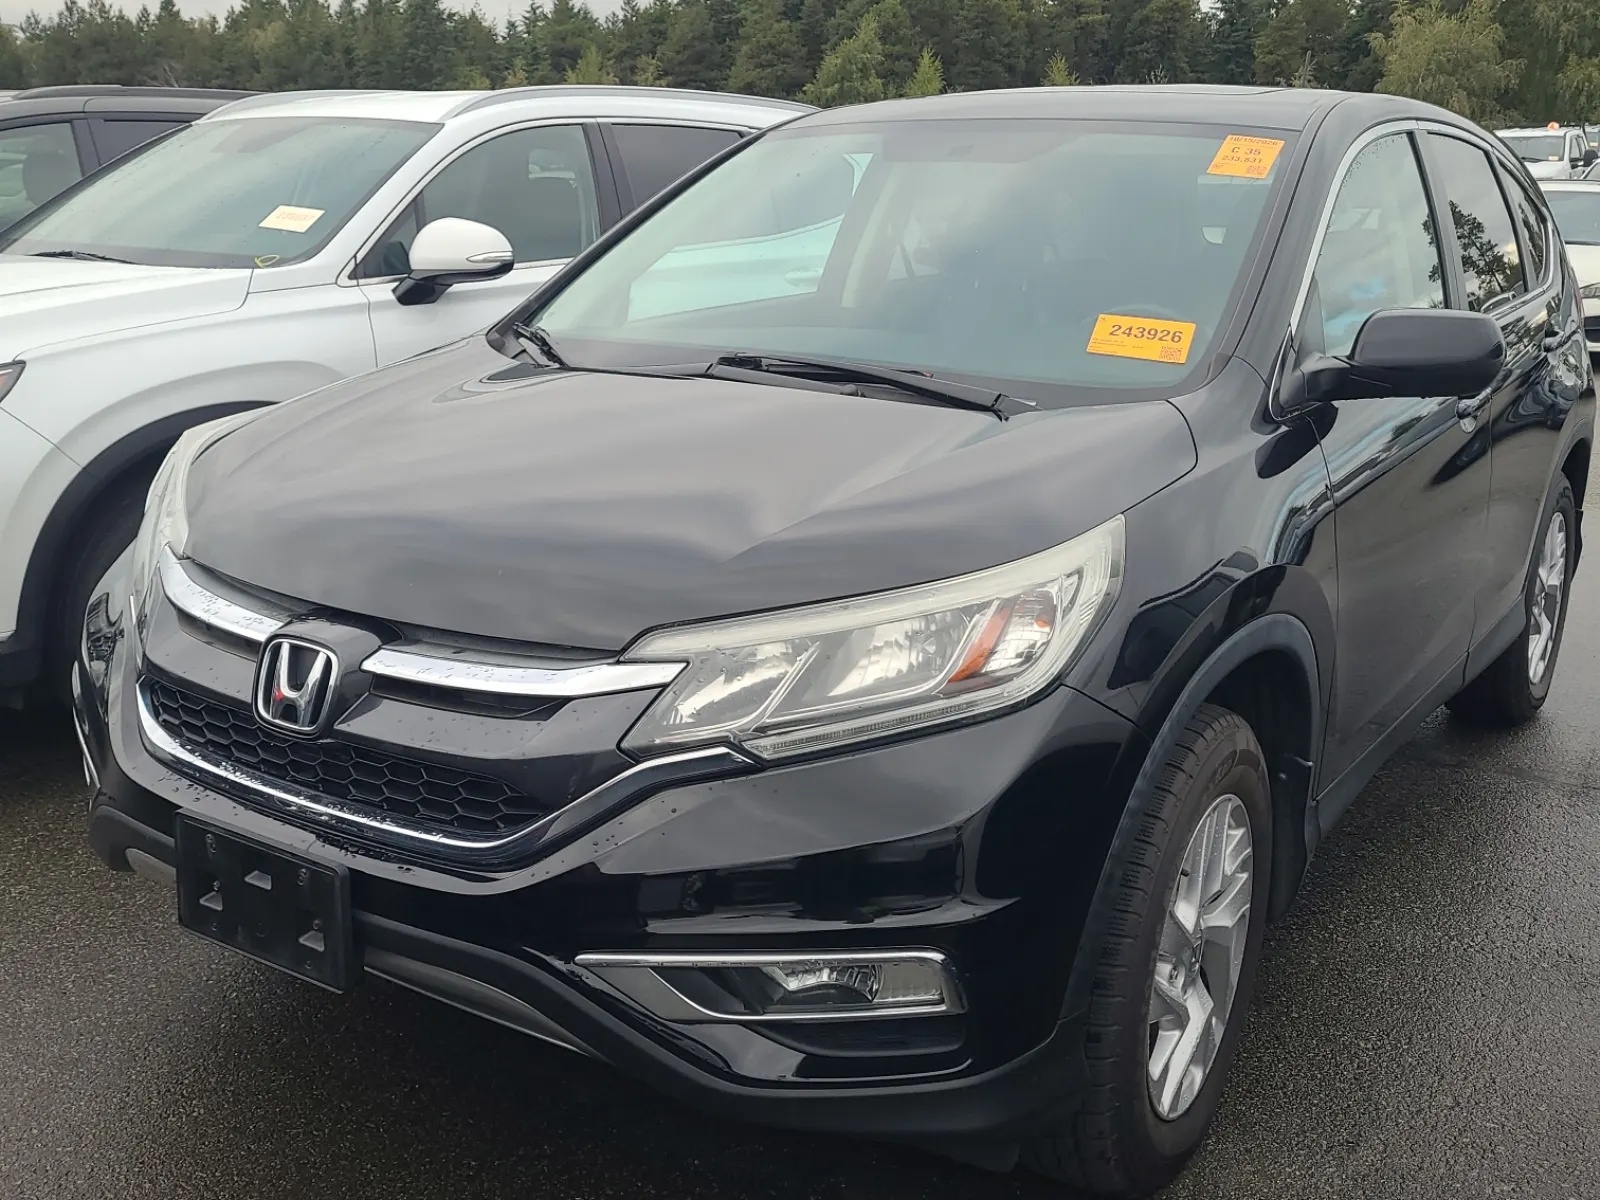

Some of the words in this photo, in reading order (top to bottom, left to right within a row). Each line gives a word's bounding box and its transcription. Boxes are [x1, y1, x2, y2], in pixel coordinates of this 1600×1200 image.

[1231, 146, 1241, 154] C
[1245, 147, 1262, 156] 35
[1109, 324, 1183, 344] 243926
